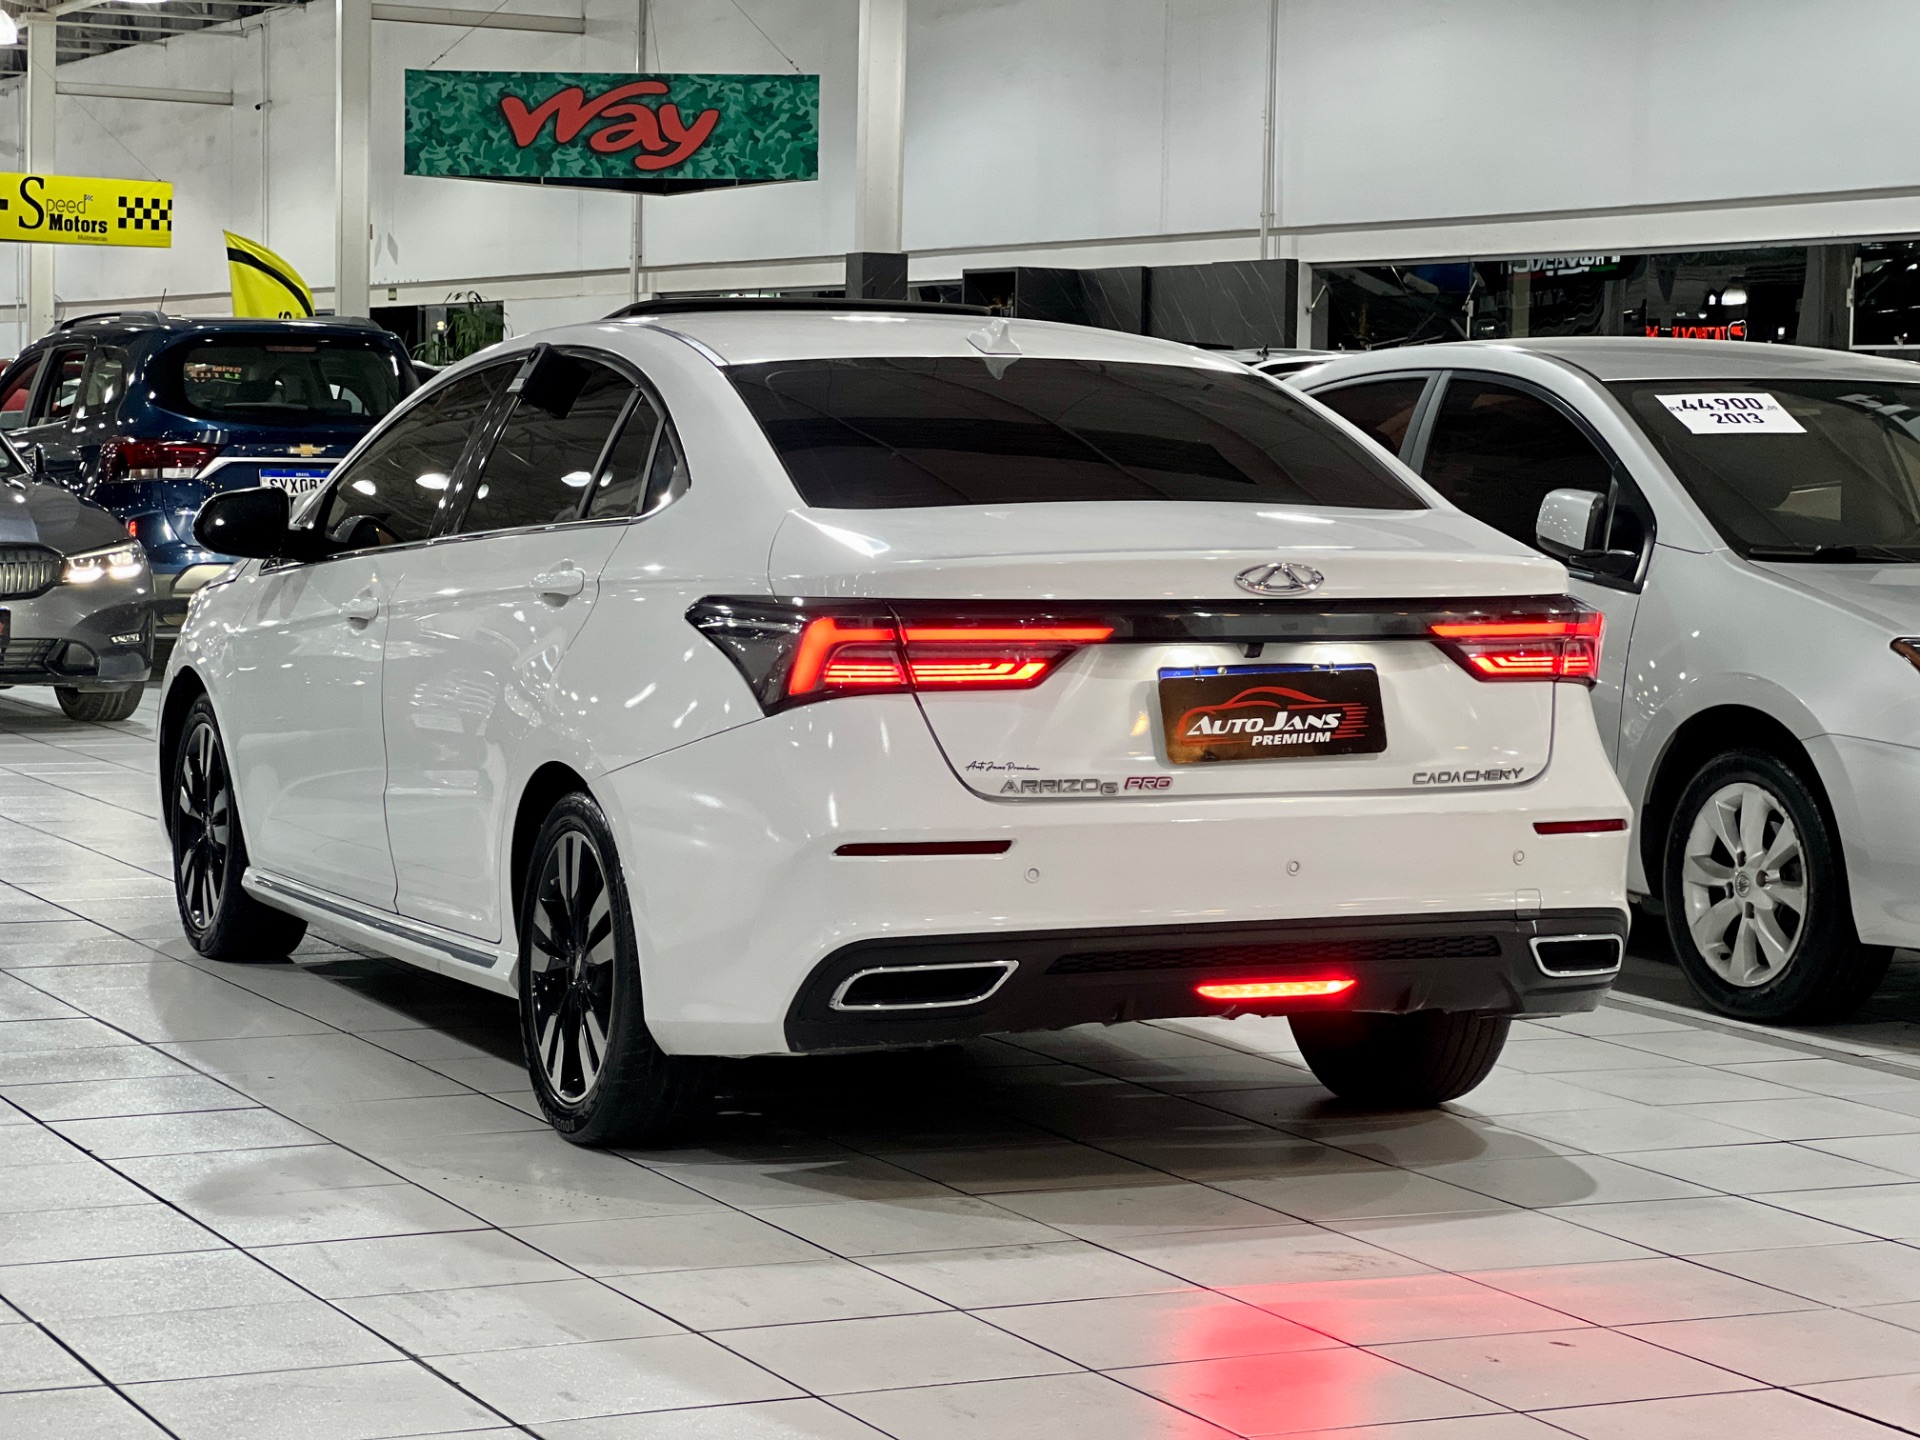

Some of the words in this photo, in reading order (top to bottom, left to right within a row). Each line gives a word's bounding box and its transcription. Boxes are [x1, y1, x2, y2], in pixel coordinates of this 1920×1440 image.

[501, 80, 719, 170] Way
[18, 176, 87, 229] Speed
[49, 213, 108, 234] Motors
[1709, 412, 1765, 424] 2013
[1251, 731, 1331, 747] PREMIUM
[1124, 776, 1173, 791] PRO
